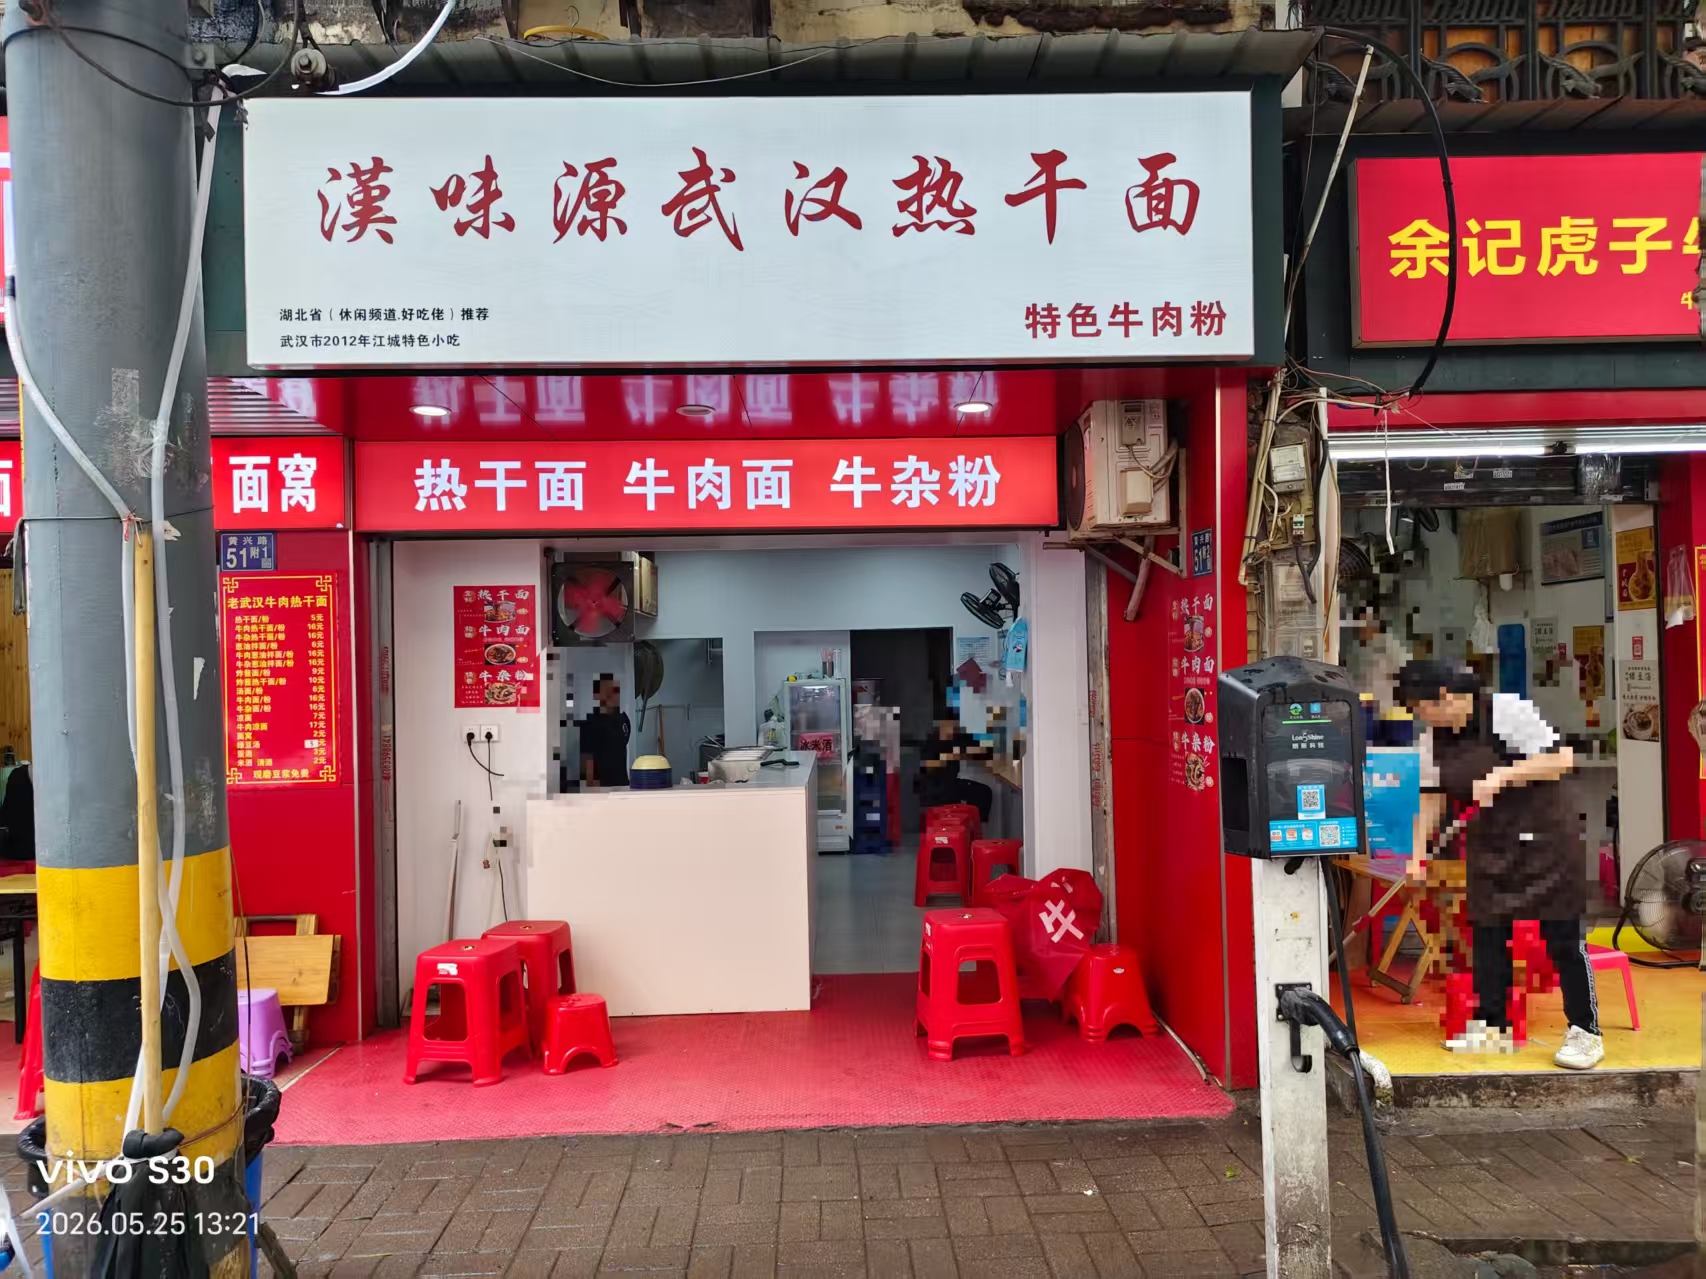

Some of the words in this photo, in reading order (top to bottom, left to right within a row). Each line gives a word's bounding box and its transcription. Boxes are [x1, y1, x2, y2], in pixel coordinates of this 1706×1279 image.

[317, 147, 1201, 251] 漢味源武汉热干面
[1025, 300, 1227, 339] 特色牛肉粉
[280, 334, 461, 348] 武汉市2012年江城特色小吃
[228, 453, 318, 513] 面窝
[413, 458, 587, 512] 热干面
[623, 457, 794, 511] 牛肉面
[830, 455, 1001, 509] 牛杂粉
[228, 536, 268, 546] 黄兴路
[227, 595, 328, 610] 老武汉牛肉热干面
[478, 589, 531, 601] 热干面
[1180, 593, 1214, 616] 热干面
[478, 624, 531, 637] 牛肉面
[1181, 655, 1215, 676] 牛肉面
[1181, 731, 1216, 754] 牛杂粉
